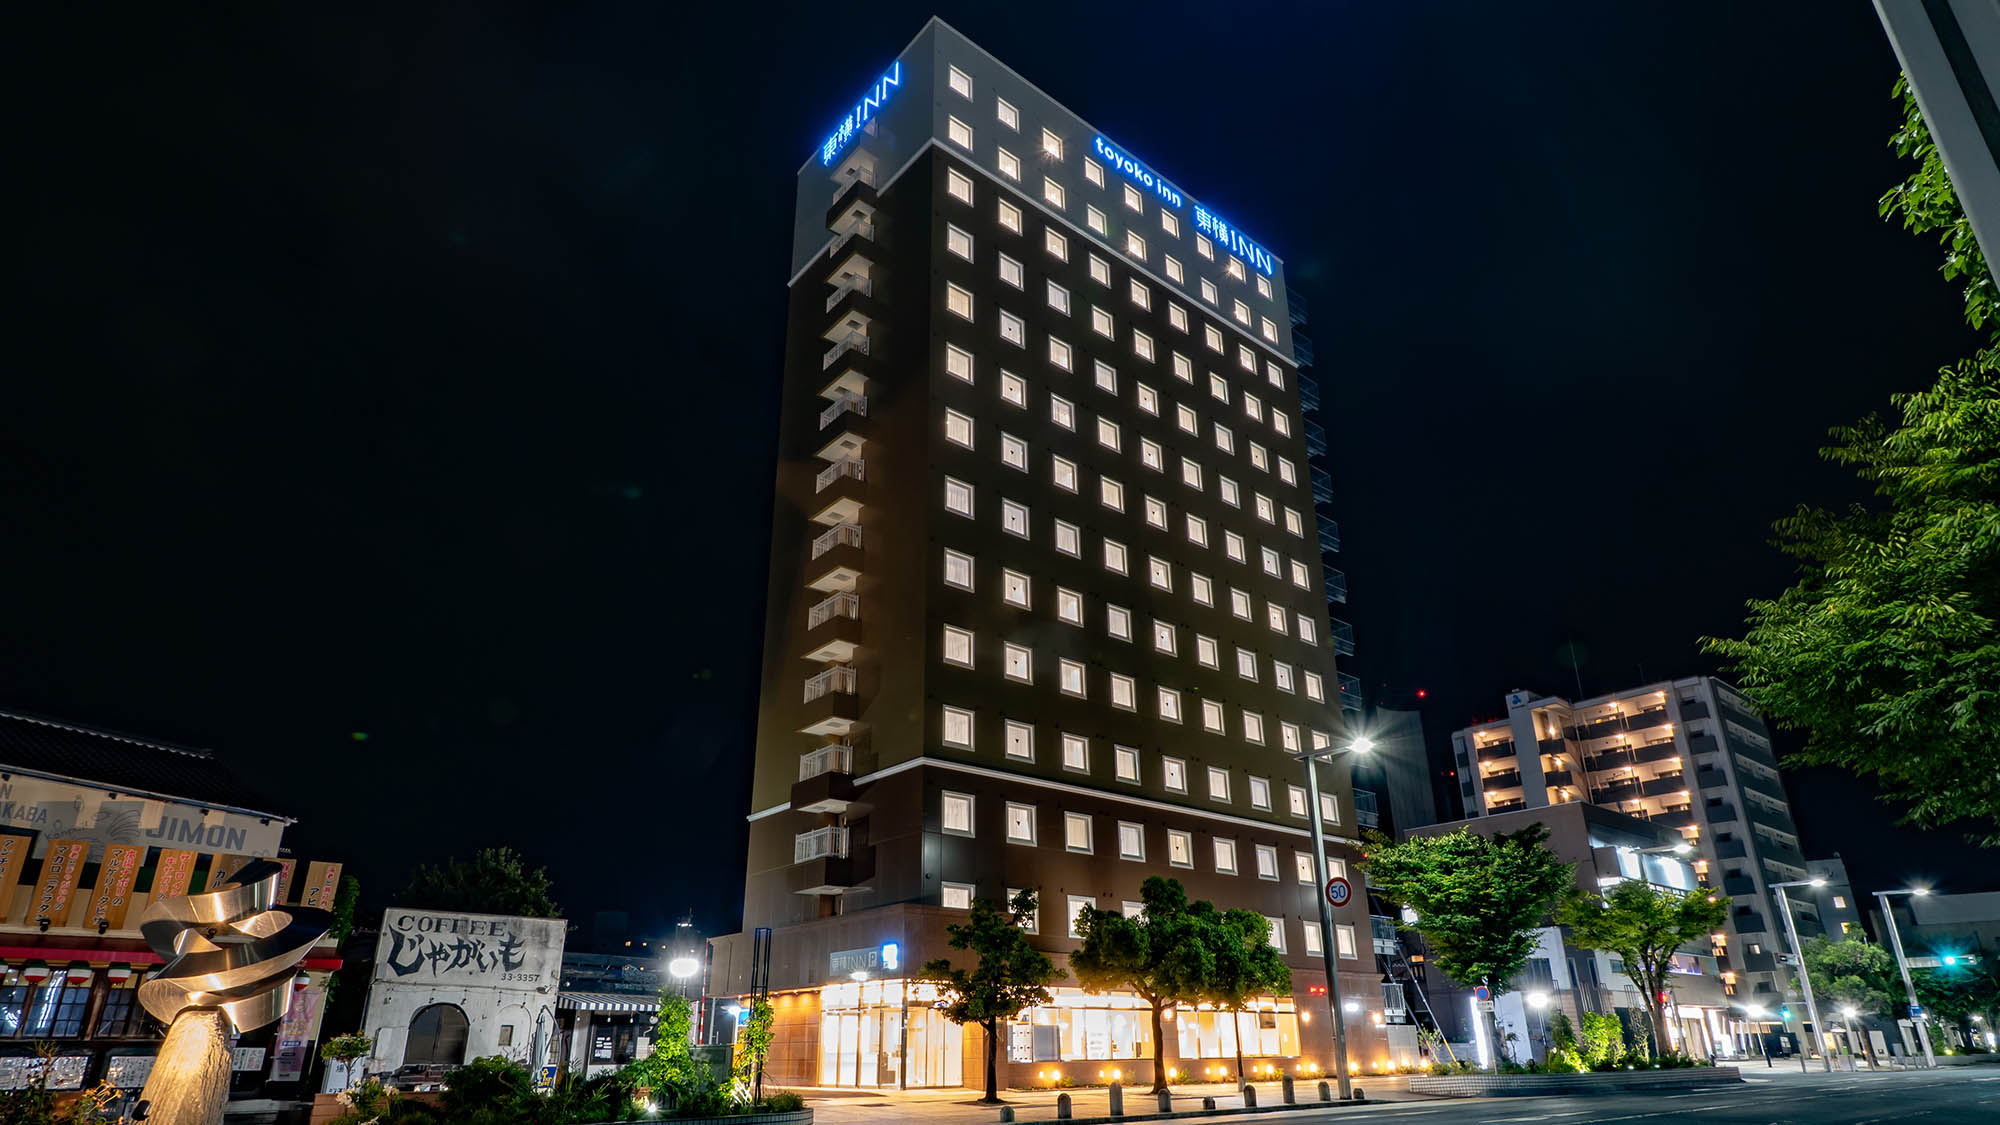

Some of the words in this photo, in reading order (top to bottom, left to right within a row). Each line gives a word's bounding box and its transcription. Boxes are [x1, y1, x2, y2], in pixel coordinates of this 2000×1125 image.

[823, 61, 899, 166] 東横INN
[1096, 137, 1152, 186] toyoko
[1157, 179, 1181, 207] inn
[1194, 205, 1272, 275] 東横INN
[145, 816, 247, 851] JIMON
[1330, 885, 1346, 899] 50
[398, 915, 507, 937] COFFEE
[387, 923, 527, 978] じゃがいも
[501, 972, 540, 983] 33-3357
